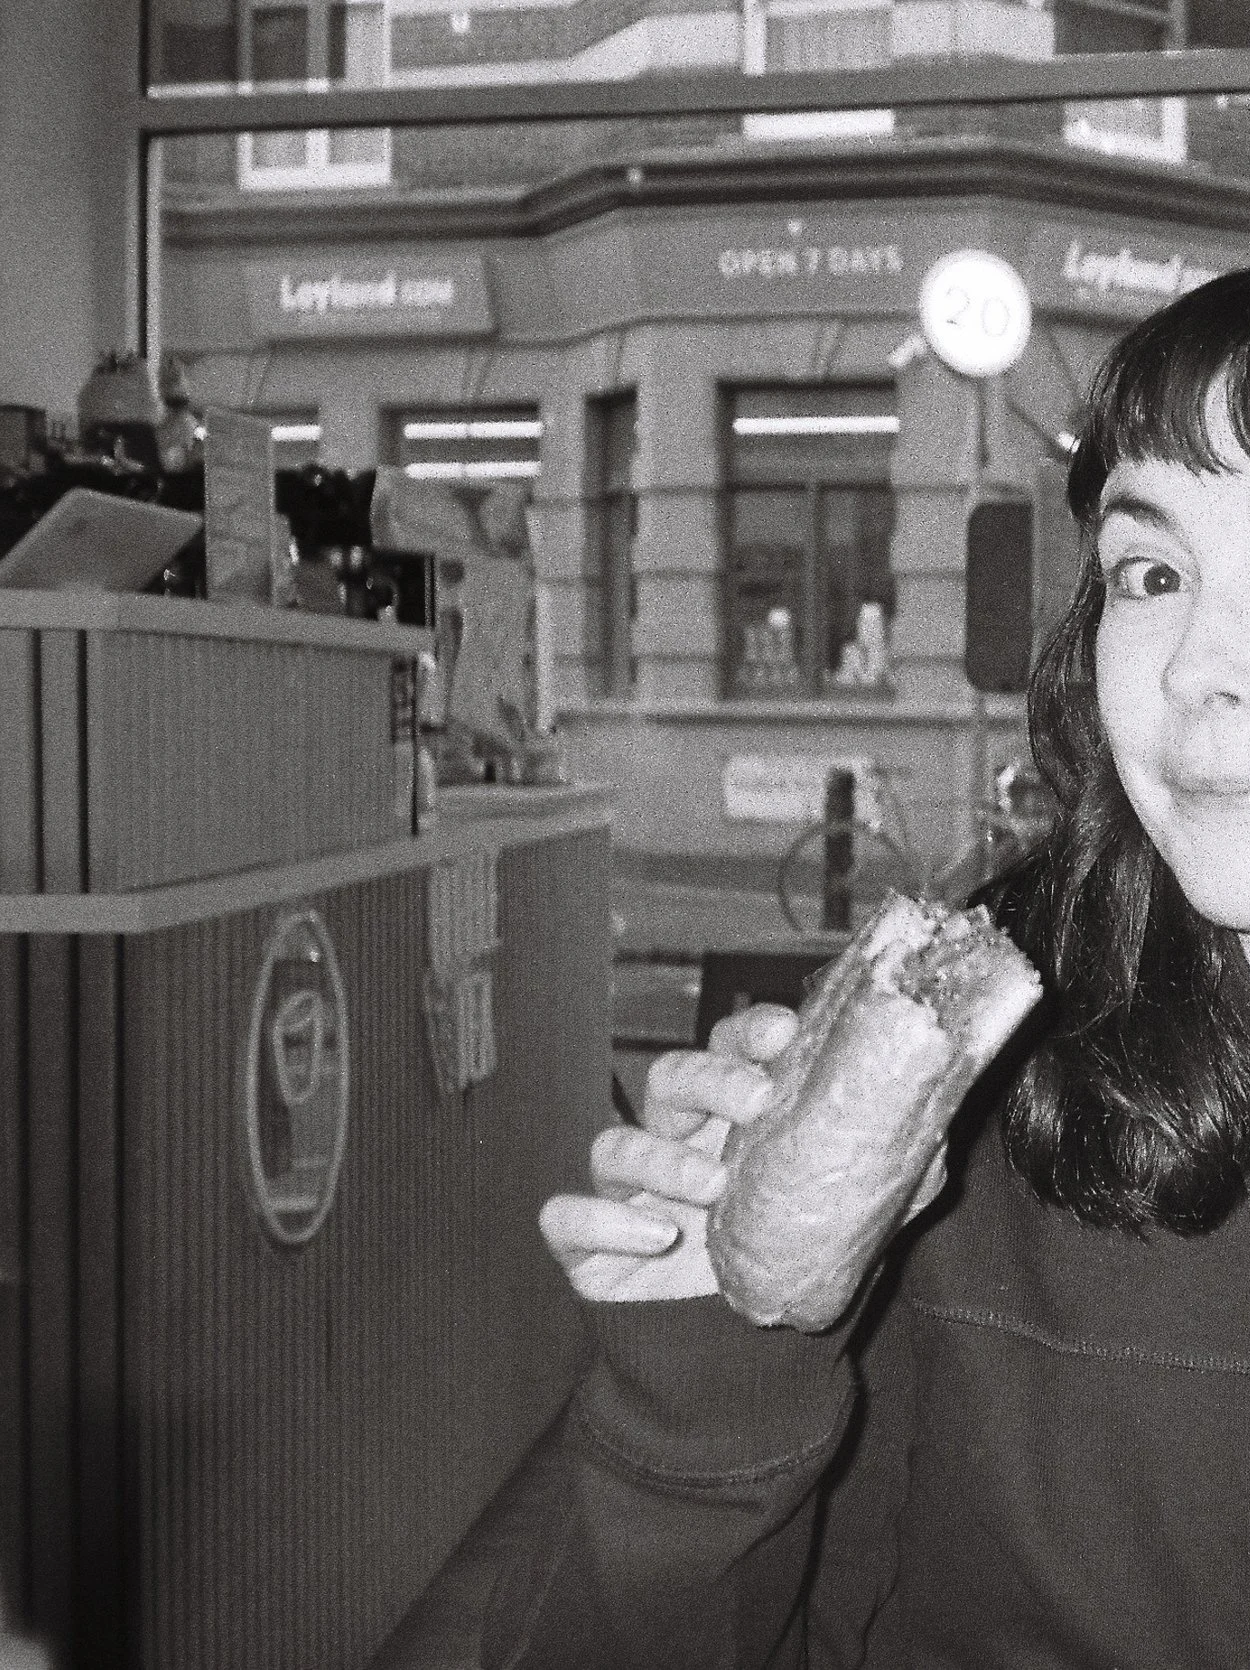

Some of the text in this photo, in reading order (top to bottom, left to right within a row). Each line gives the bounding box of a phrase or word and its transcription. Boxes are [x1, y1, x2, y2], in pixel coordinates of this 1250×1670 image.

[718, 244, 903, 279] OPEN 7 DAYS
[945, 283, 1012, 339] 20
